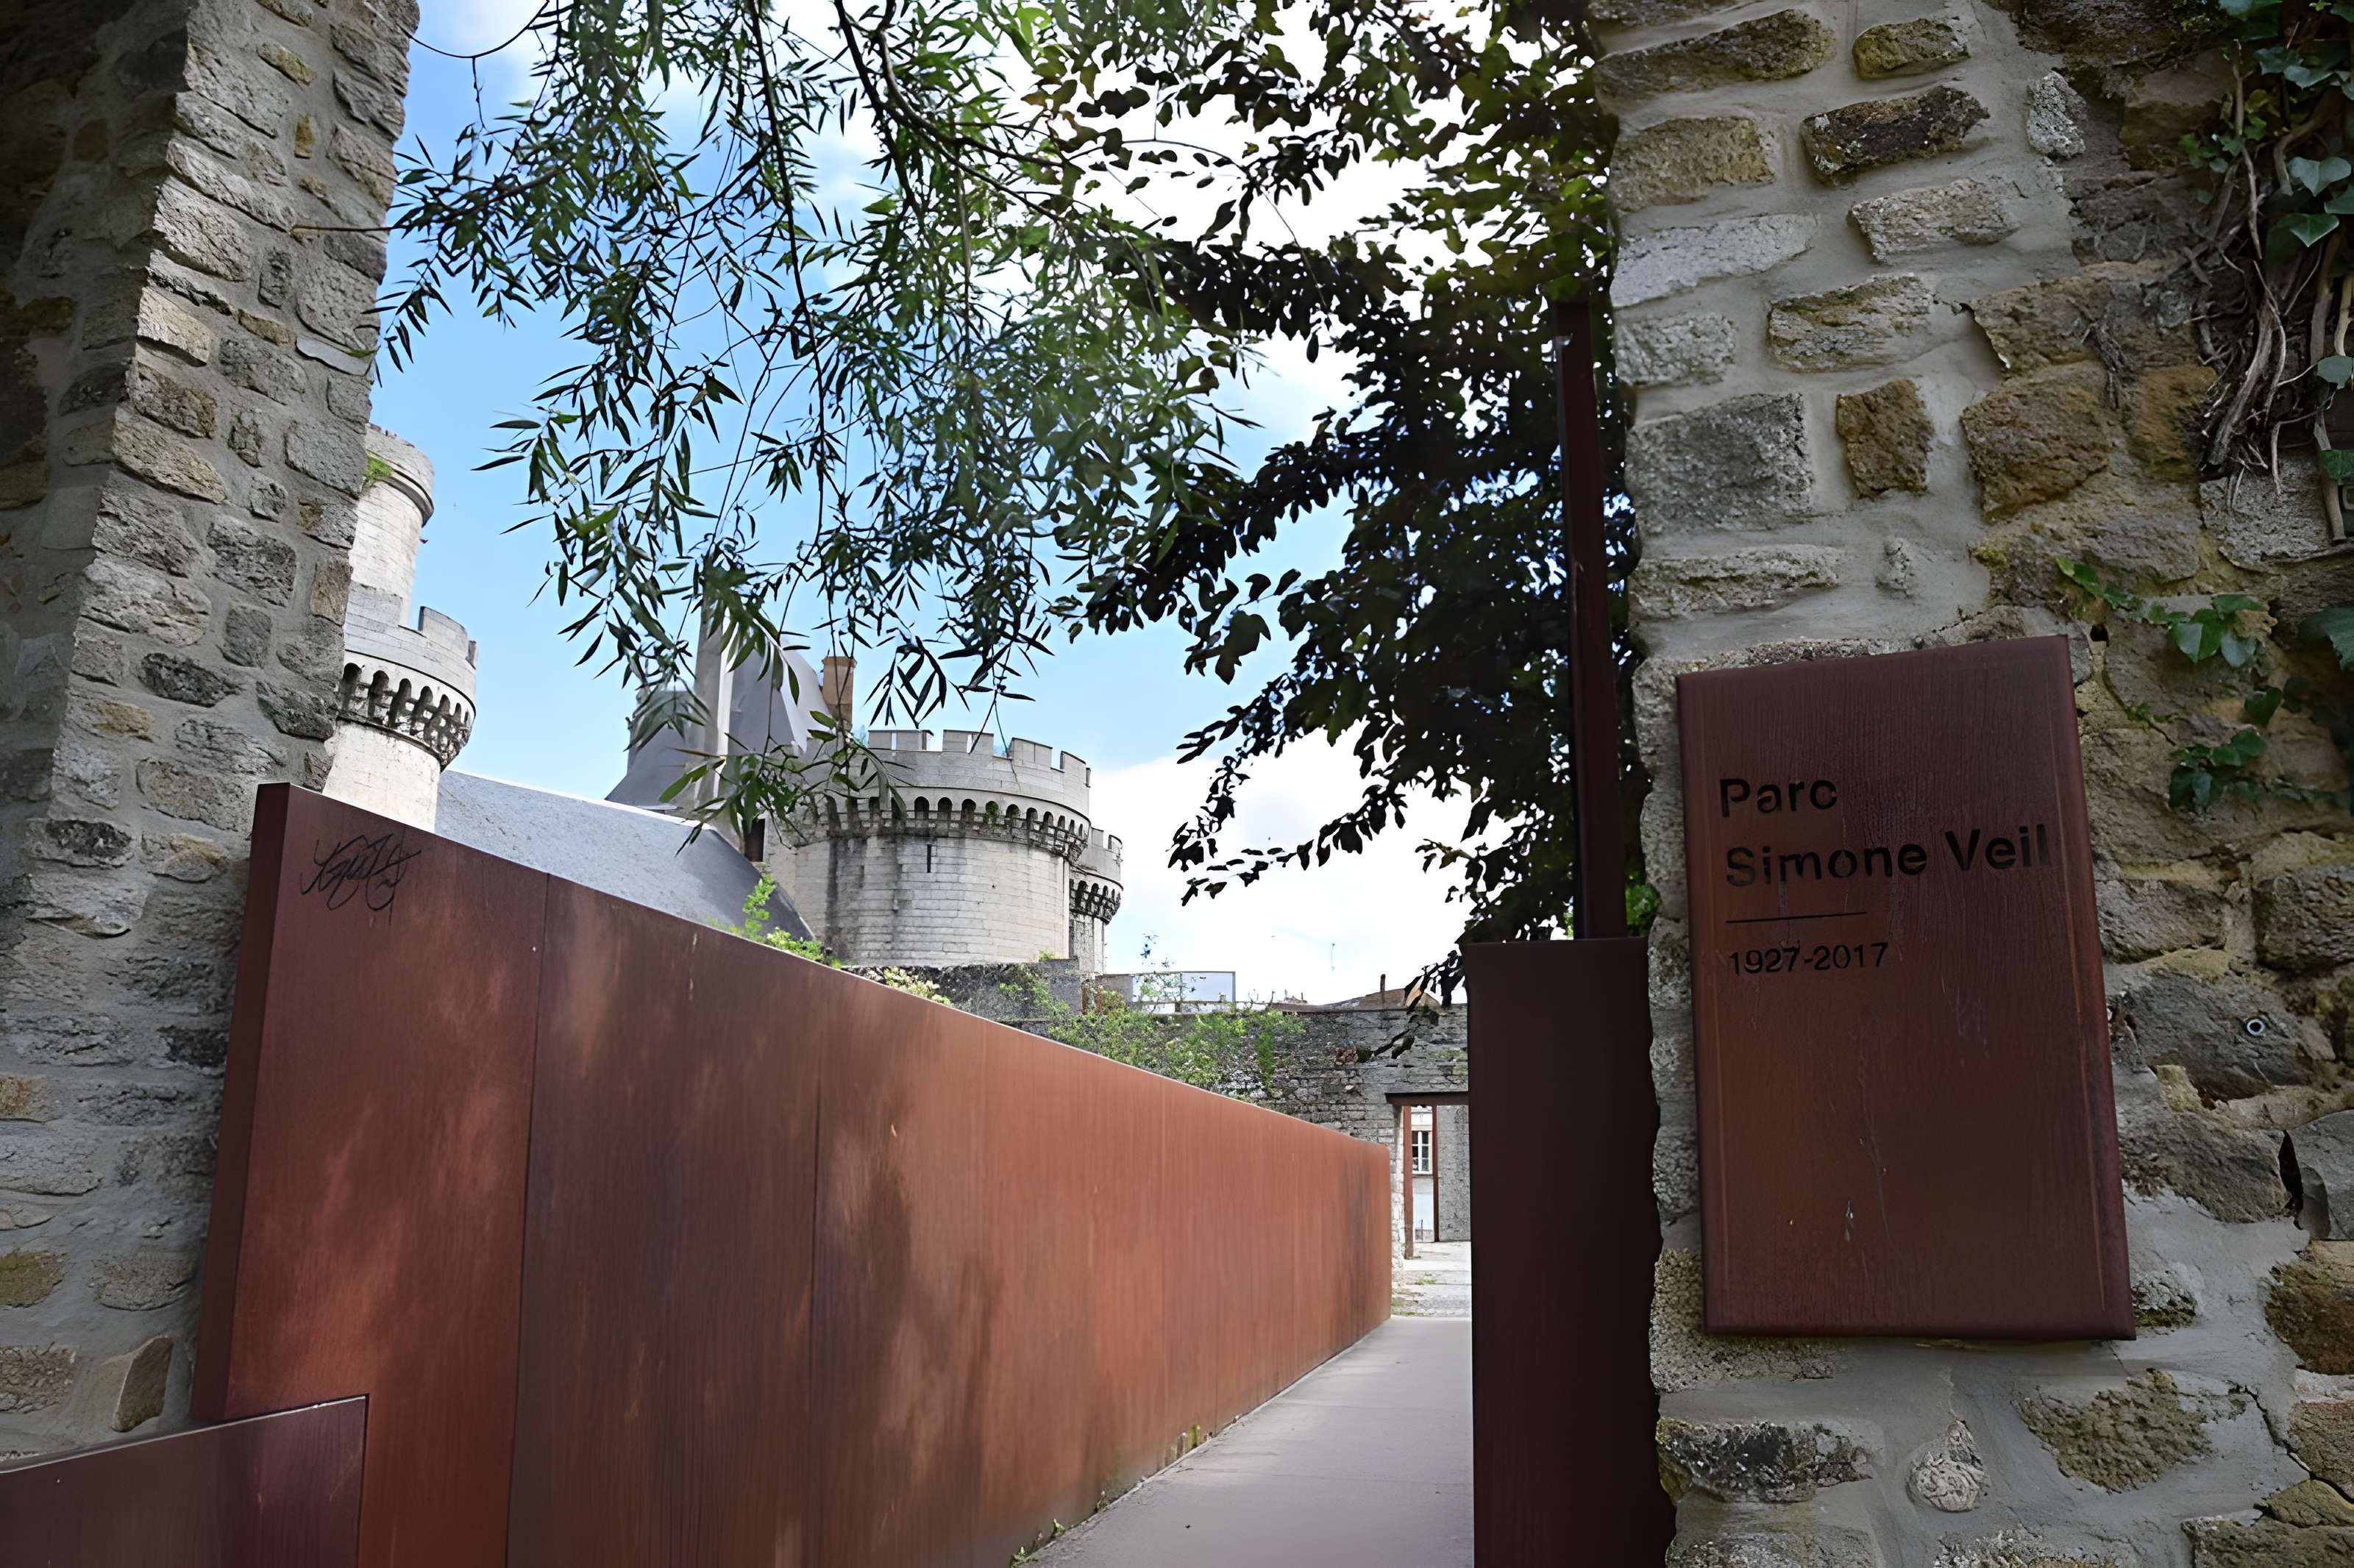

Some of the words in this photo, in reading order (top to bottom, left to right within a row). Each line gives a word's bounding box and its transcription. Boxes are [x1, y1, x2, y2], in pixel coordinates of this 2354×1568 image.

[1720, 778, 1838, 817] Parc
[1726, 841, 1927, 887] Simone
[1944, 823, 2050, 872] Veil
[1729, 941, 1888, 977] 1927-2017
